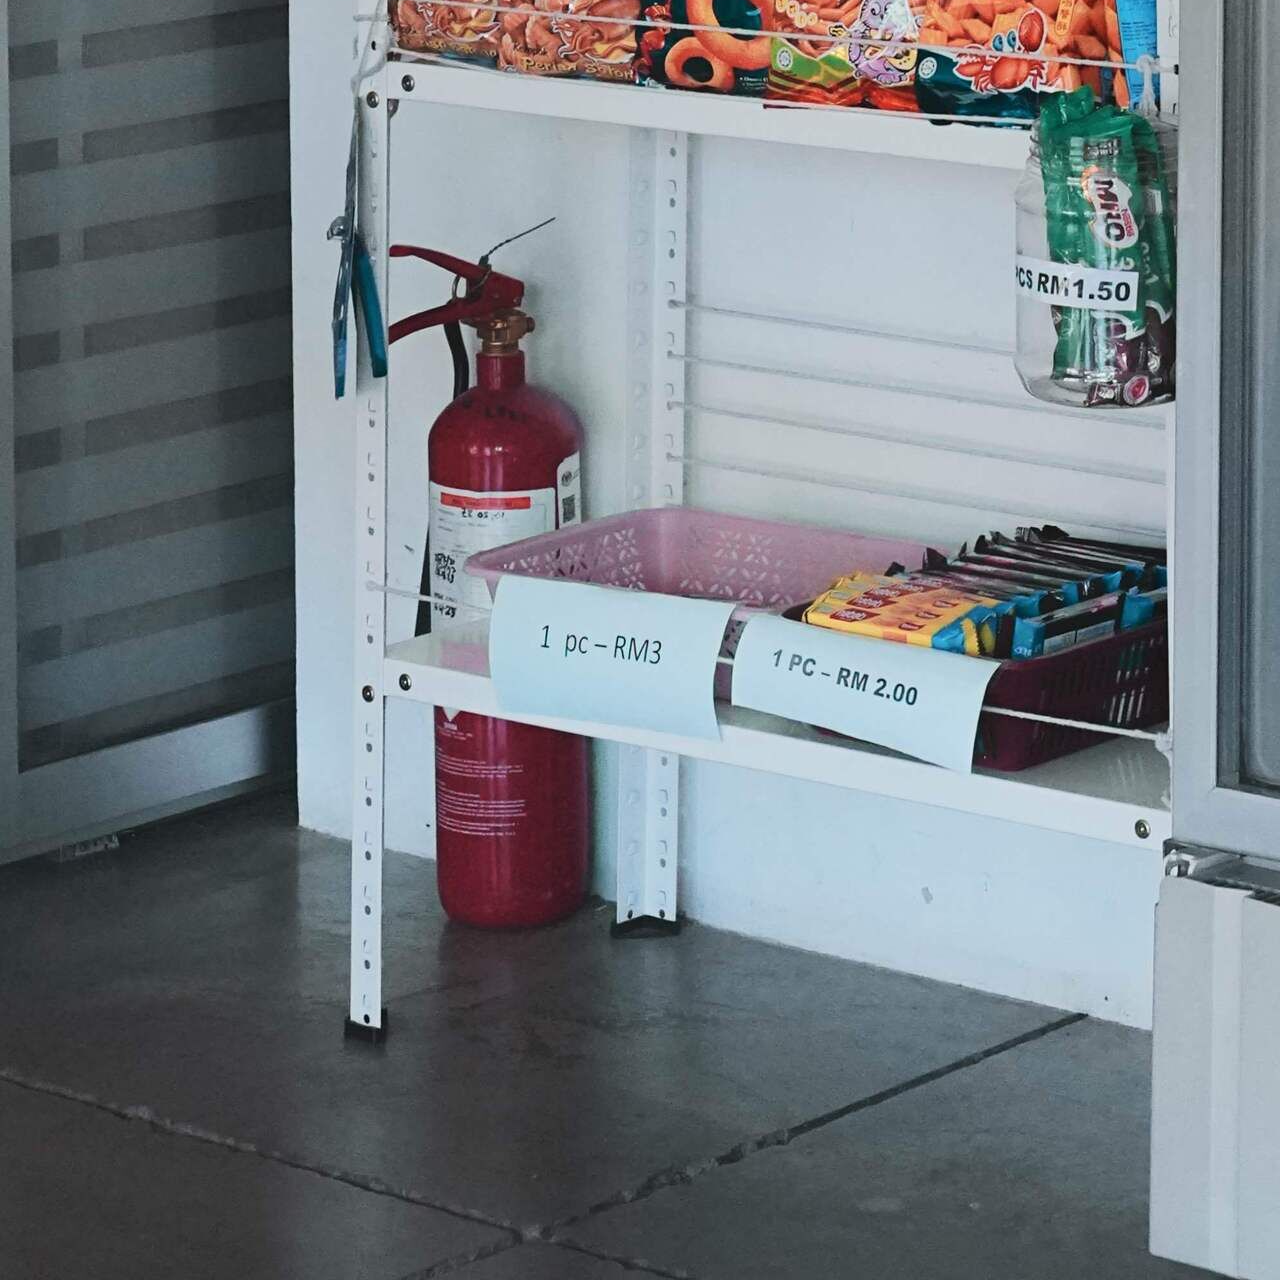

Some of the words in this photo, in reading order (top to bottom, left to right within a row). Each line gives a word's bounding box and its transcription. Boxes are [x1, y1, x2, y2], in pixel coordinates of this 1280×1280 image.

[540, 625, 551, 649] 1
[773, 649, 782, 668] 1
[789, 654, 815, 677] PC
[836, 667, 869, 693] RM
[874, 678, 919, 707] 2.00
